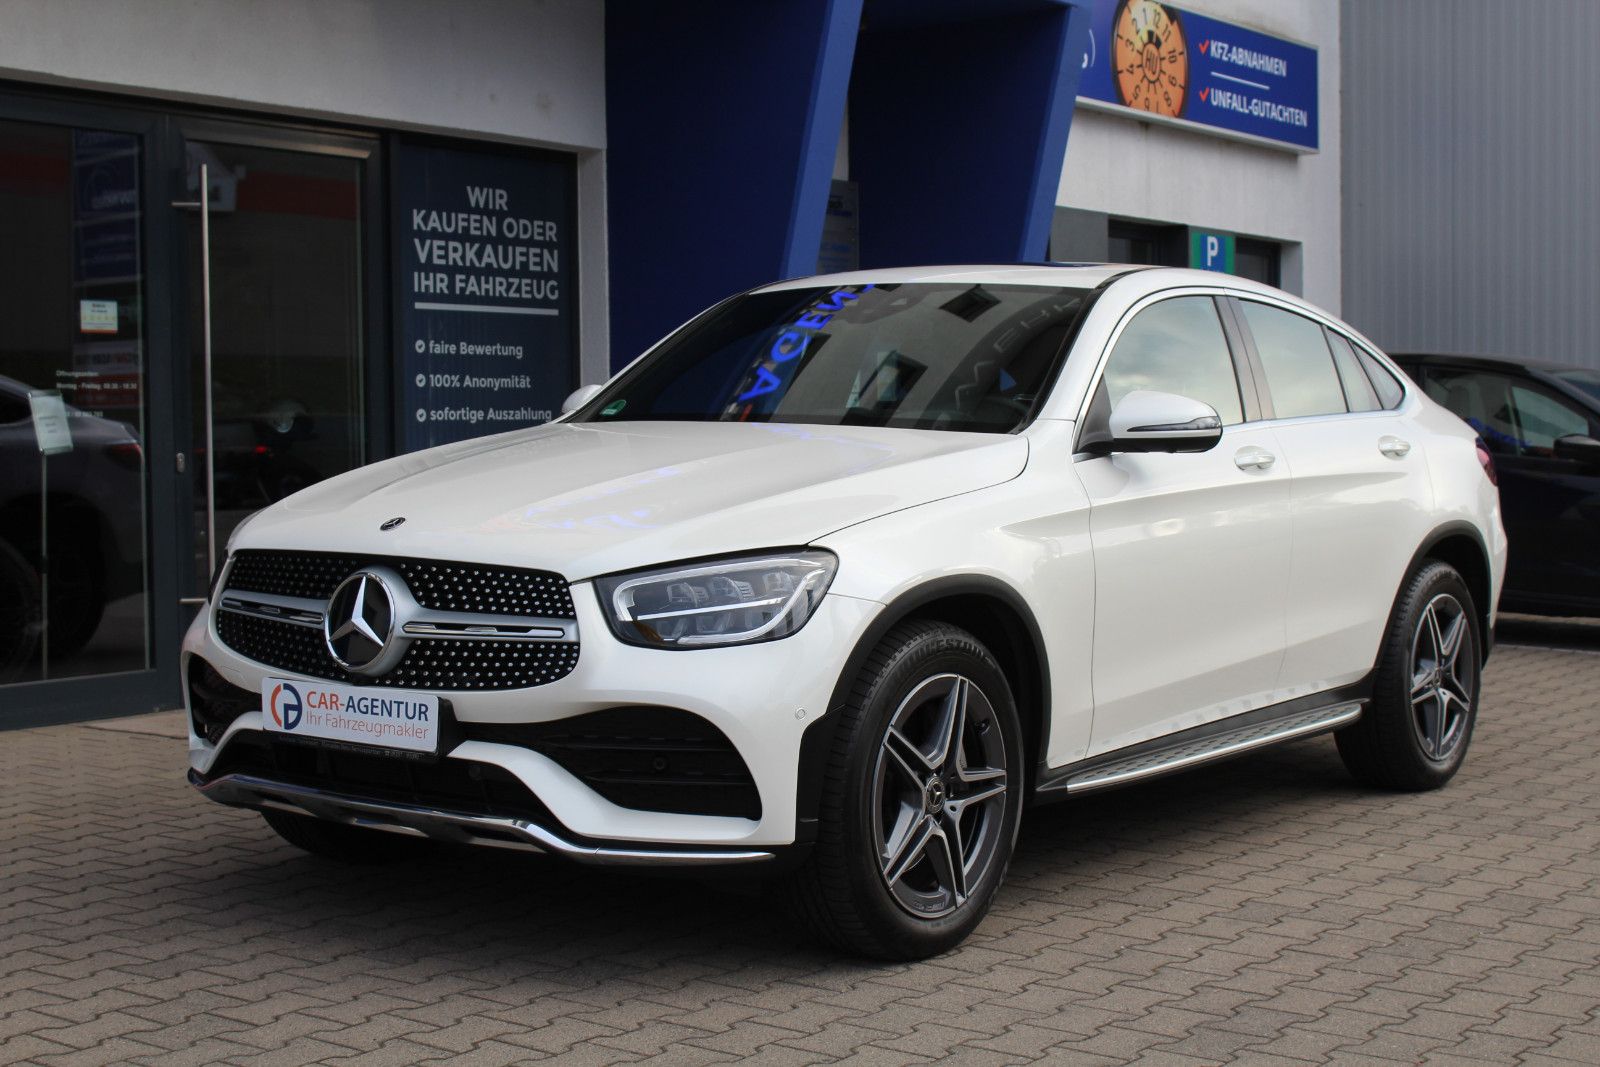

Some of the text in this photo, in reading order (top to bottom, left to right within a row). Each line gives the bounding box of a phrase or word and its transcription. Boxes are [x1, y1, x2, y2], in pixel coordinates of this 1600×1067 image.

[1131, 17, 1141, 35] 2
[1152, 8, 1161, 29] 12
[1125, 38, 1136, 52] 3
[1162, 23, 1172, 43] 11
[1145, 49, 1159, 76] HU
[1167, 48, 1177, 64] 10
[1210, 39, 1287, 77] KFZ-ABNAHMEN
[1163, 91, 1172, 107] 8
[1210, 87, 1308, 127] UNFALL-GUTACHTEN
[466, 186, 508, 211] WIR
[412, 208, 558, 242] KAUFEN ODER
[413, 238, 560, 273] VERKAUFEN
[1207, 235, 1219, 267] P
[413, 271, 559, 300] IHR FAHRZEUG
[428, 340, 523, 360] faire Bewertung
[428, 373, 532, 391] 100% Anonymität
[429, 406, 552, 424] sofortige Auszahlung
[306, 691, 429, 722] CAR-AGENTUR
[306, 711, 430, 740] Ihr Fahrzeugmakler
